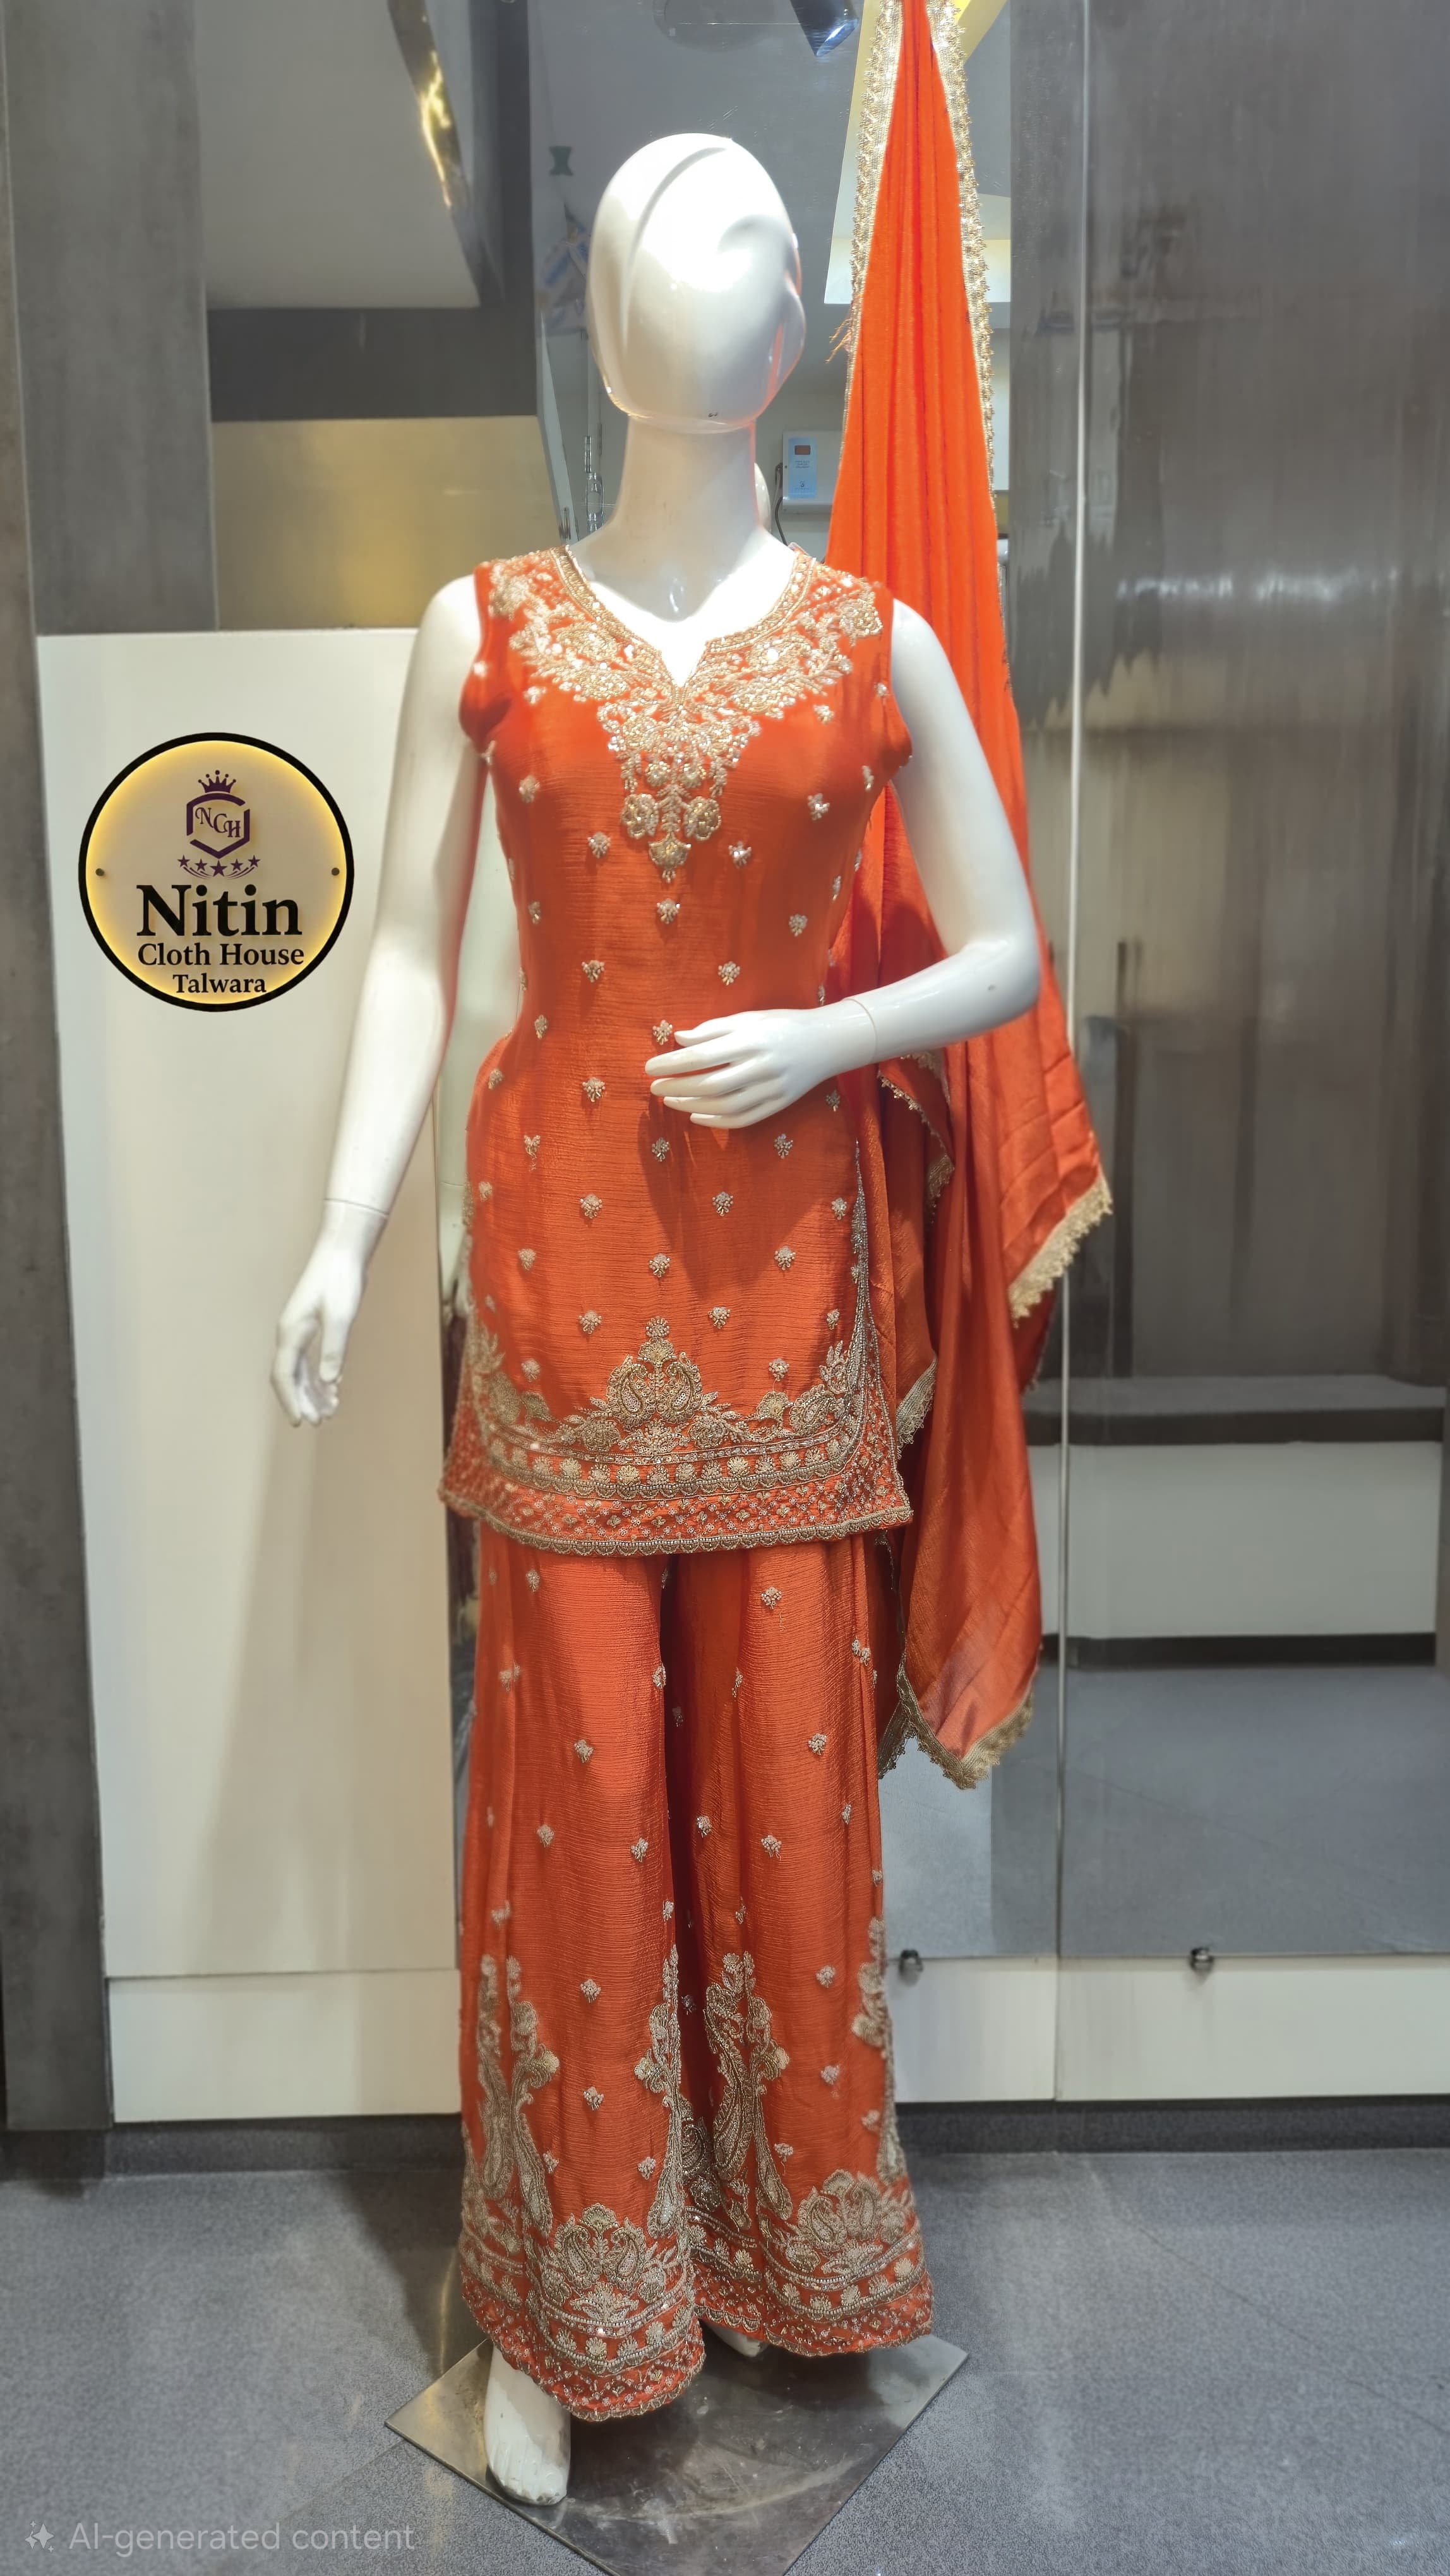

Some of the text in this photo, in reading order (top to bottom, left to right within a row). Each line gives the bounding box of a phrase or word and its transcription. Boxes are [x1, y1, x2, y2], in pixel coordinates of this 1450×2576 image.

[195, 807, 241, 838] NCH
[136, 883, 303, 937] Nitin
[138, 942, 304, 965] Cloth House
[172, 973, 267, 994] Talwara
